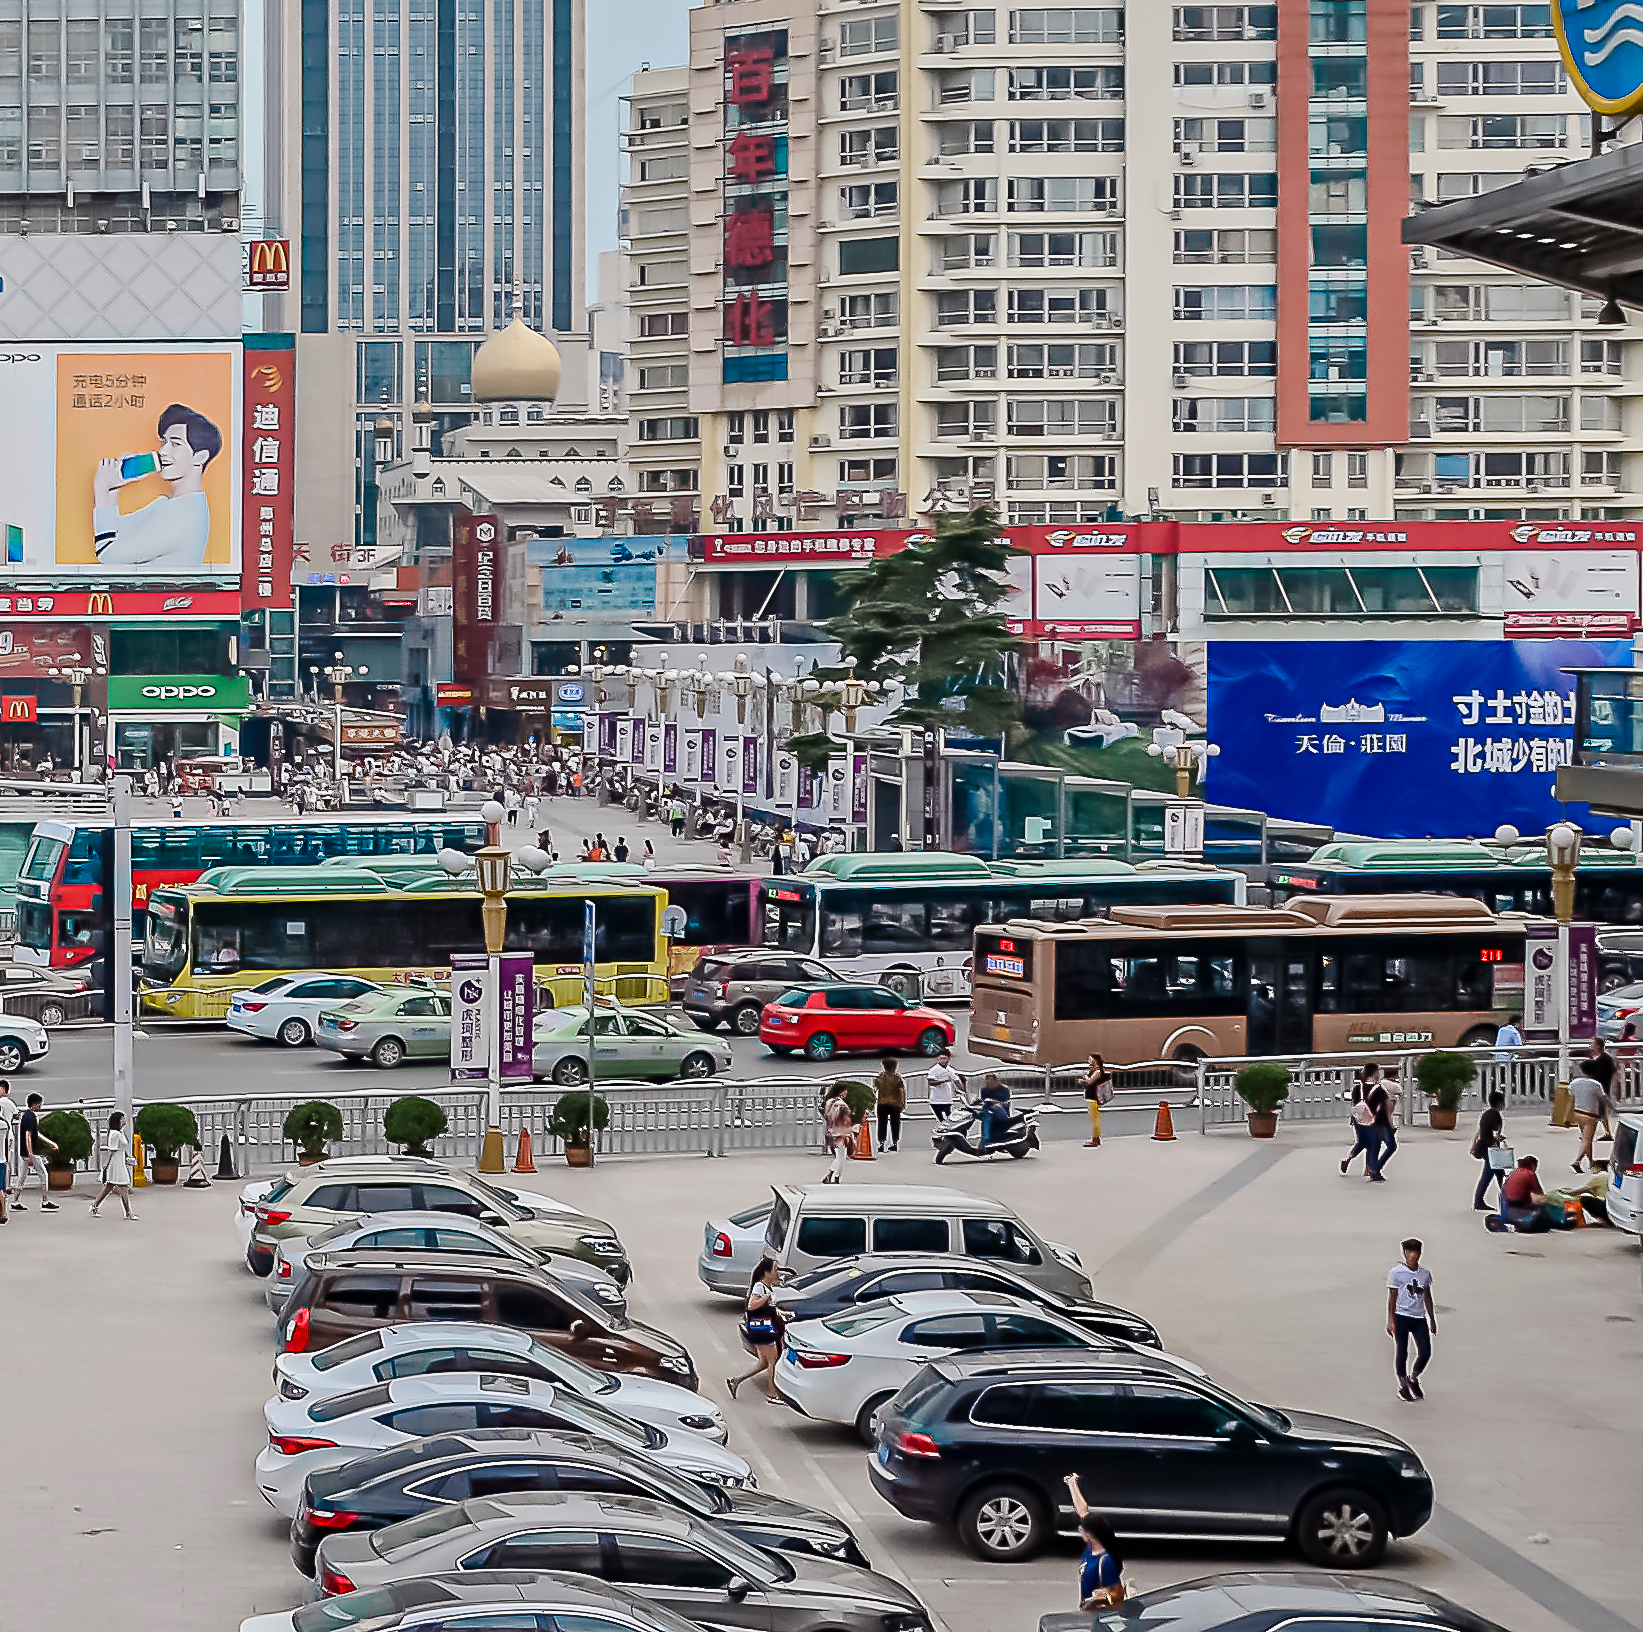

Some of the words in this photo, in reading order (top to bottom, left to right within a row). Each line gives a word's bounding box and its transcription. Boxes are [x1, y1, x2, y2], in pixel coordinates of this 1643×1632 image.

[72, 374, 147, 389] 充电5分钟
[71, 394, 146, 408] 通话2小时
[1450, 737, 1574, 773] 北城少有的
